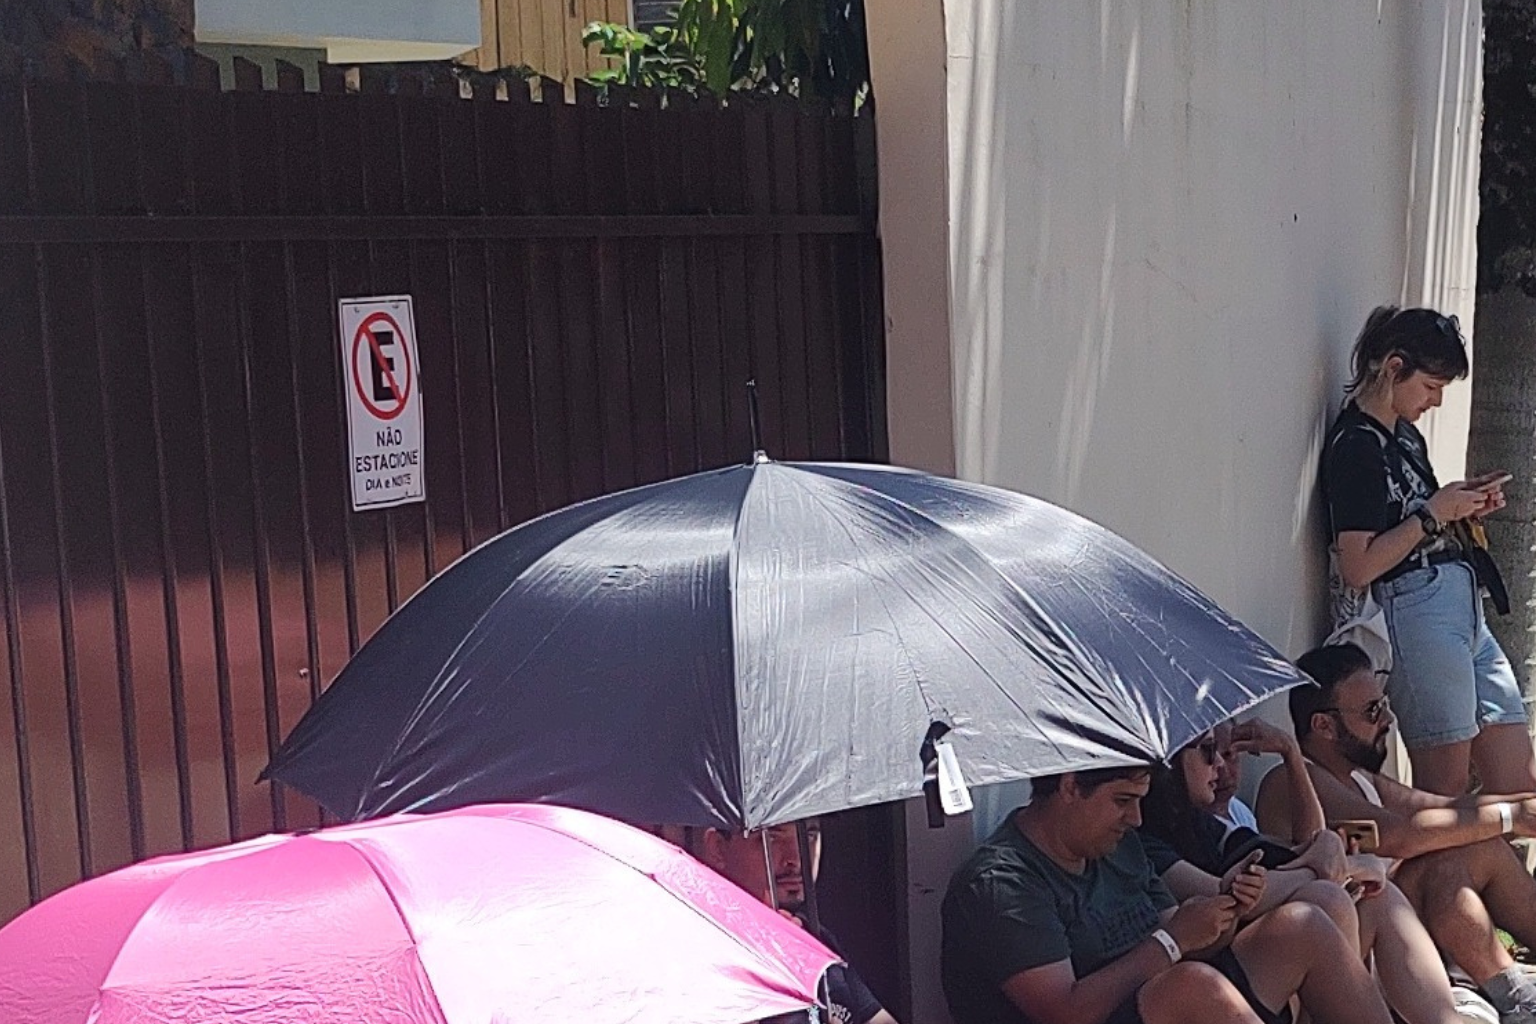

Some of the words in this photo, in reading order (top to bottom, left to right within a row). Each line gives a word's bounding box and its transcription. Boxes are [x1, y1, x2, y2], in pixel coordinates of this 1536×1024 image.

[376, 427, 403, 447] NÃO
[355, 449, 419, 473] ESTACIONE
[365, 477, 382, 491] DIA
